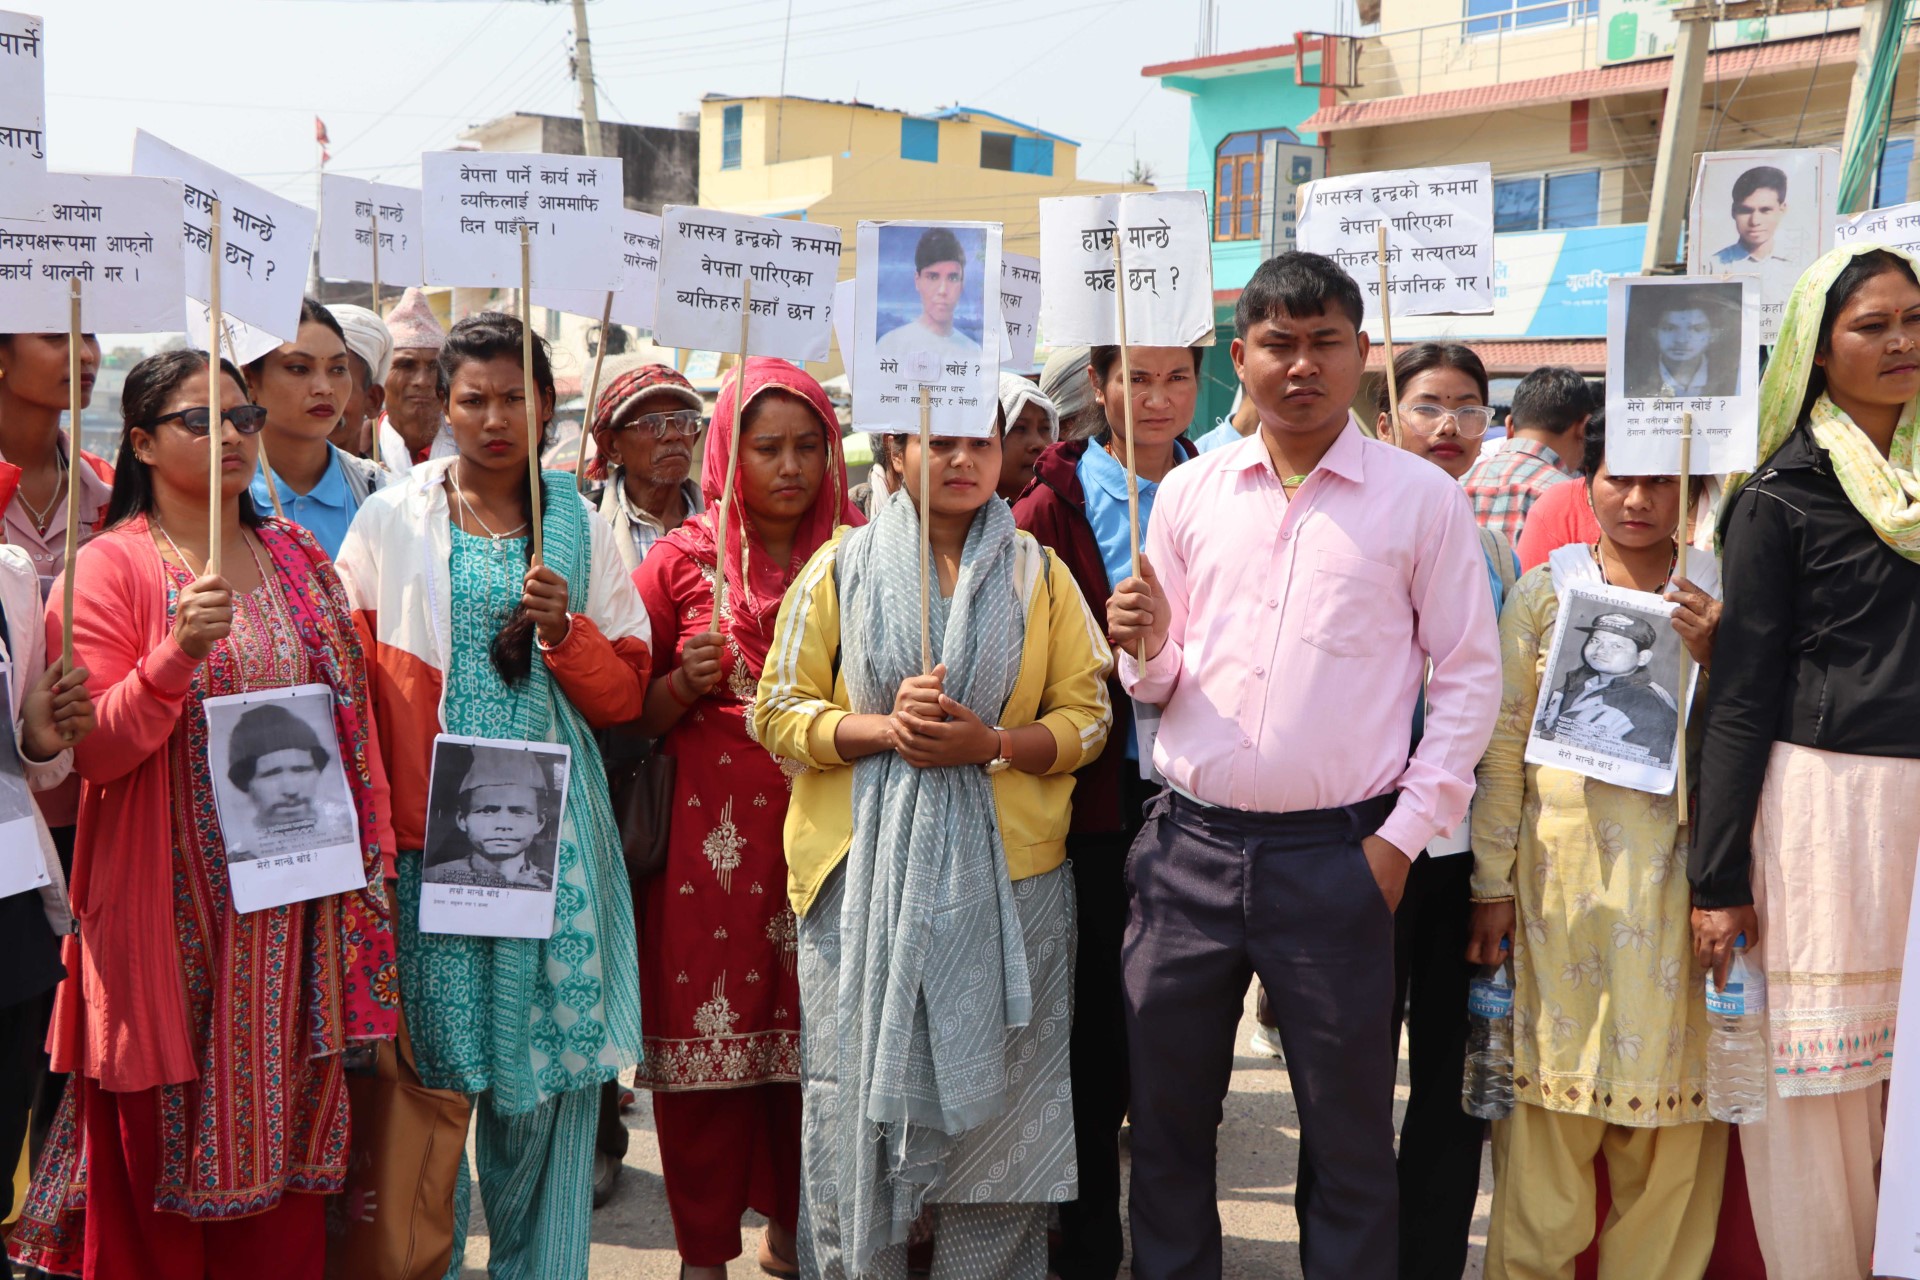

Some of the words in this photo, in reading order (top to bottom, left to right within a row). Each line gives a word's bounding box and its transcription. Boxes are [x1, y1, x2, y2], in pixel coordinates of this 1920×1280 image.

[506, 164, 532, 184] पार्ने
[540, 167, 568, 185] कार्य
[577, 168, 597, 187] गर्ने
[538, 194, 599, 212] आममाफि
[1371, 180, 1419, 203] द्वन्द्वको
[1428, 180, 1478, 196] क्रममा
[52, 199, 102, 222] आयोग
[355, 198, 374, 218] हाम्रो
[379, 202, 404, 223] मान्छे
[233, 206, 276, 241] मान्छे
[460, 216, 485, 234] दिन
[1128, 218, 1171, 249] मान्छे
[1390, 212, 1453, 233] पारिएका
[1838, 226, 1857, 240] १०
[106, 231, 153, 258] आफ्नो
[401, 233, 408, 251] ?
[678, 222, 727, 242] शसस्त्र
[735, 229, 783, 250] द्वन्द्वको
[791, 236, 841, 257] क्रममा
[225, 242, 255, 280] छन्
[265, 260, 275, 281] ?
[1411, 244, 1478, 262] सत्यतथ्य
[0, 258, 33, 281] कार्य
[104, 266, 124, 283] गर
[750, 262, 813, 288] पारिएका
[1129, 269, 1161, 299] छन्
[1170, 266, 1180, 291] ?
[1455, 276, 1478, 290] गर
[749, 297, 780, 316] कहाँ
[825, 306, 831, 322] ?
[880, 359, 898, 373] मेरो
[946, 361, 967, 376] खोई
[1628, 399, 1644, 412] मेरो
[1653, 399, 1684, 412] श्रीमान
[1691, 397, 1713, 411] खोई
[1720, 400, 1726, 411] ?
[1558, 748, 1571, 759] मेरो
[257, 859, 270, 870] मेरो
